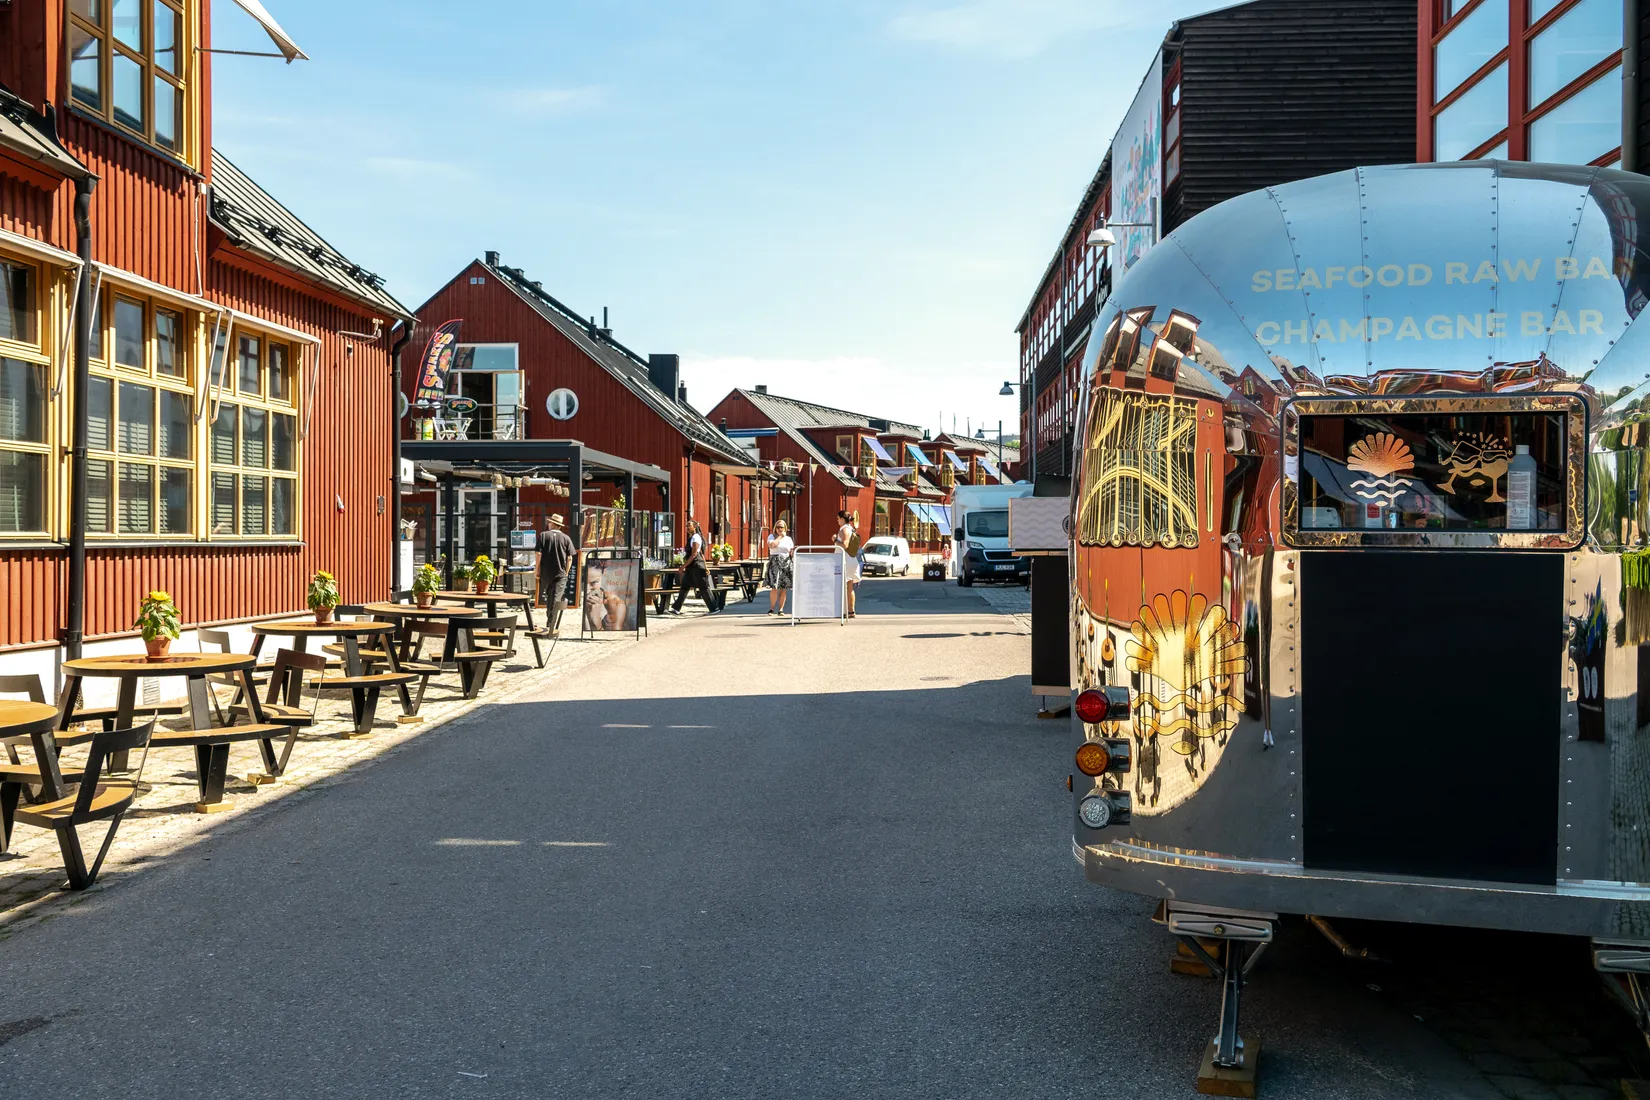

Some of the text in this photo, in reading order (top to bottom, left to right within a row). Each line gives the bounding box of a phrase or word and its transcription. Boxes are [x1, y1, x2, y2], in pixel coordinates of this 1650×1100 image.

[1251, 263, 1433, 293] SEAFOOD
[1445, 257, 1542, 286] RAW
[1255, 309, 1604, 346] CHAMPAGNE BAR
